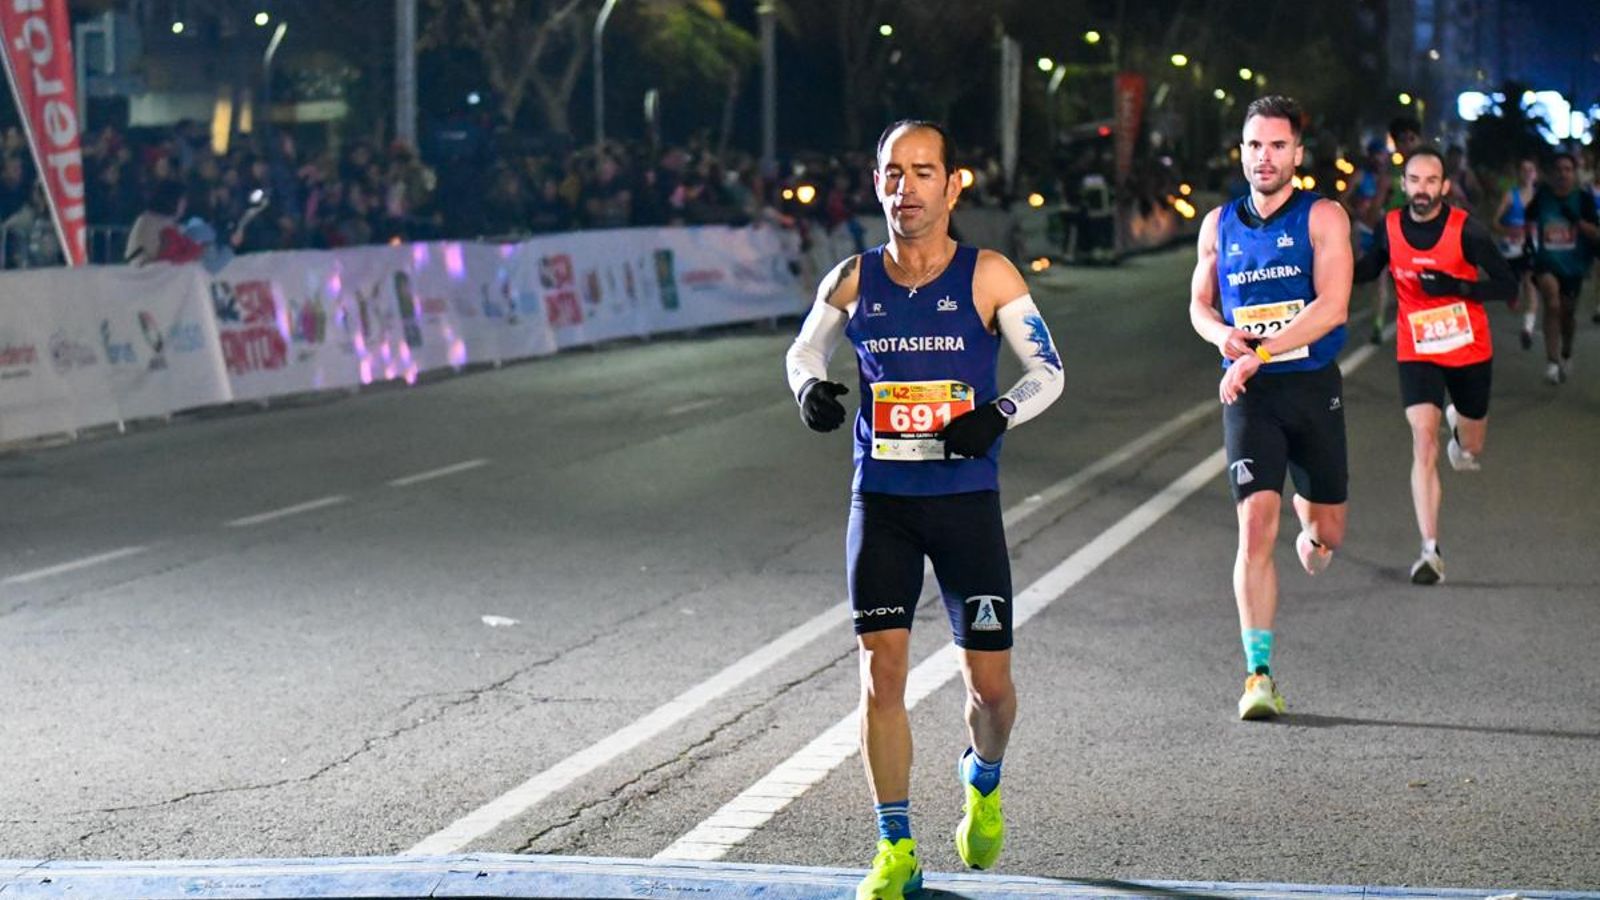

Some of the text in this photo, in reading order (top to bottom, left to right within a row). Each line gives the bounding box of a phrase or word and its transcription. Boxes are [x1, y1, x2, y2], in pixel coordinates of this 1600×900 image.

[1227, 265, 1301, 287] TROTASIERRA
[862, 336, 965, 353] TROTASIERRA
[890, 403, 952, 432] 691
